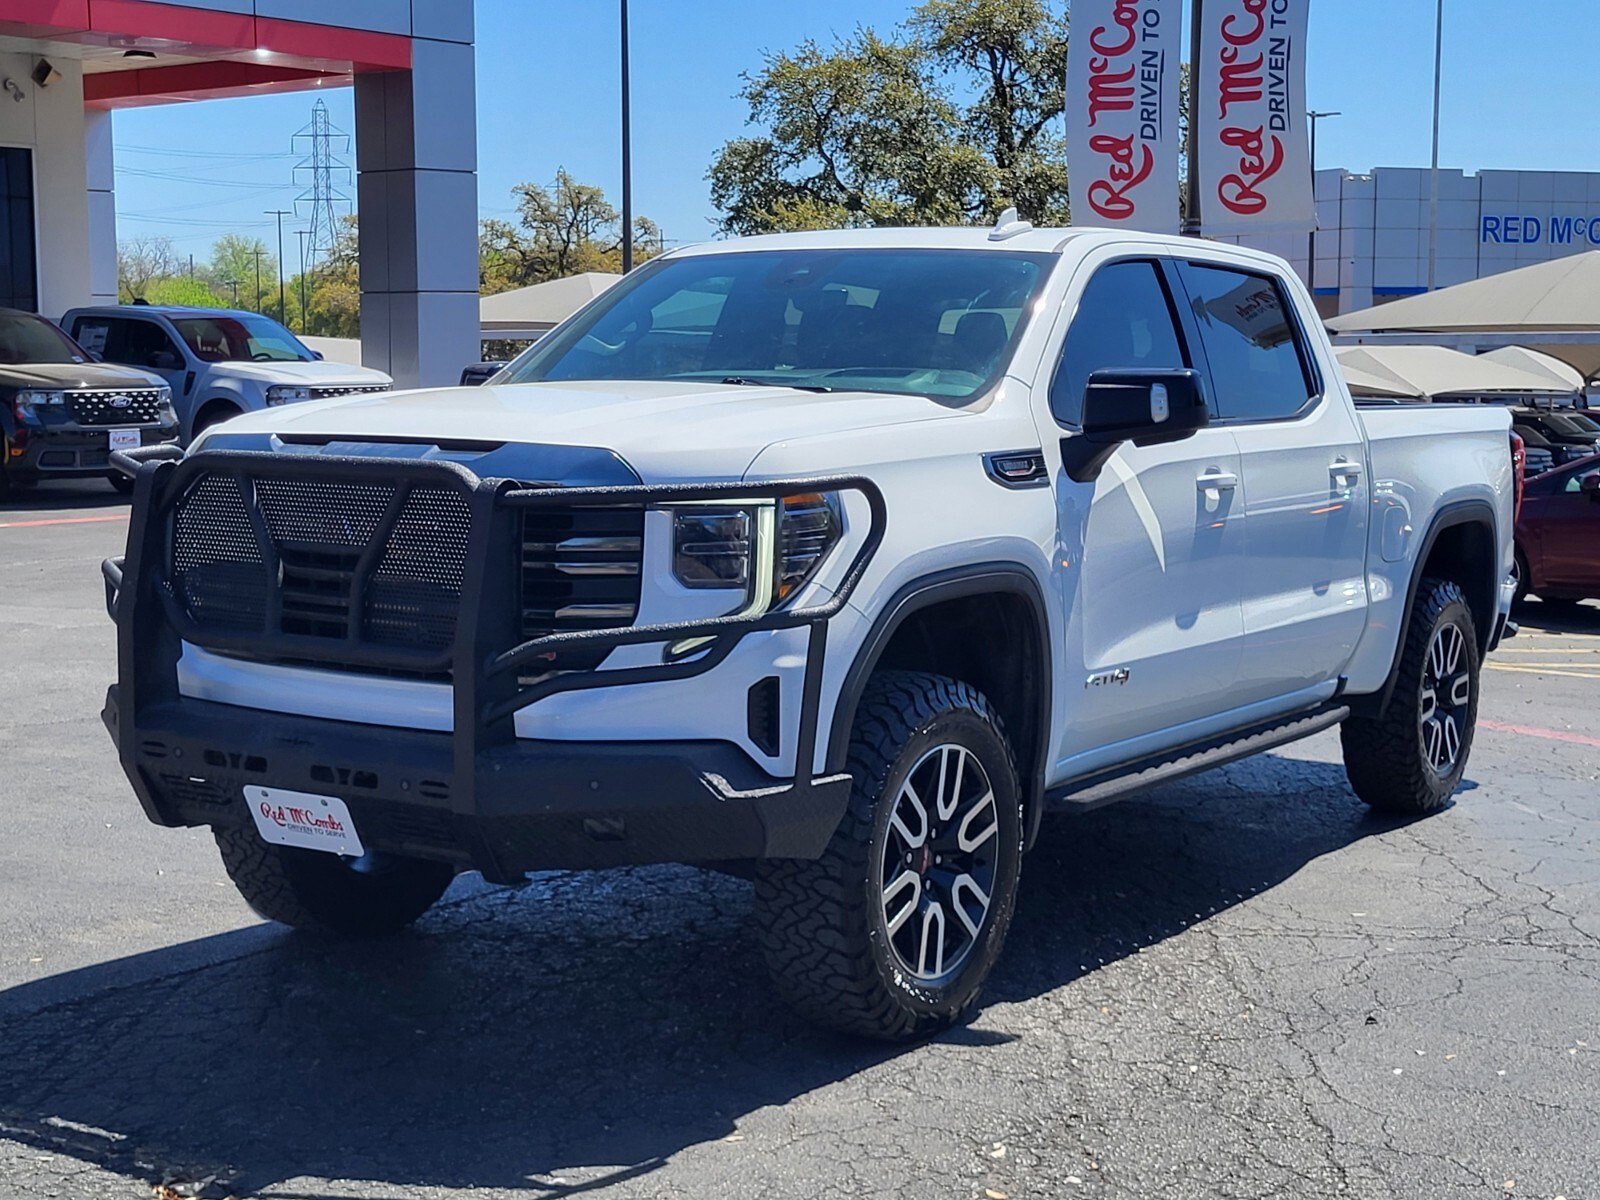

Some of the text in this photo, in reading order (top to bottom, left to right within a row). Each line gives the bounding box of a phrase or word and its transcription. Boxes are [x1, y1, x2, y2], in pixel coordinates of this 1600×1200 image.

[1140, 8, 1160, 141] DRIVEN TO
[1268, 0, 1289, 131] DRIVEN TO
[1087, 133, 1154, 220] Red
[1218, 124, 1285, 215] Red
[1482, 215, 1541, 243] RED
[260, 802, 344, 831] Red McCombs
[287, 823, 346, 838] DRIVEN TO SERVE
